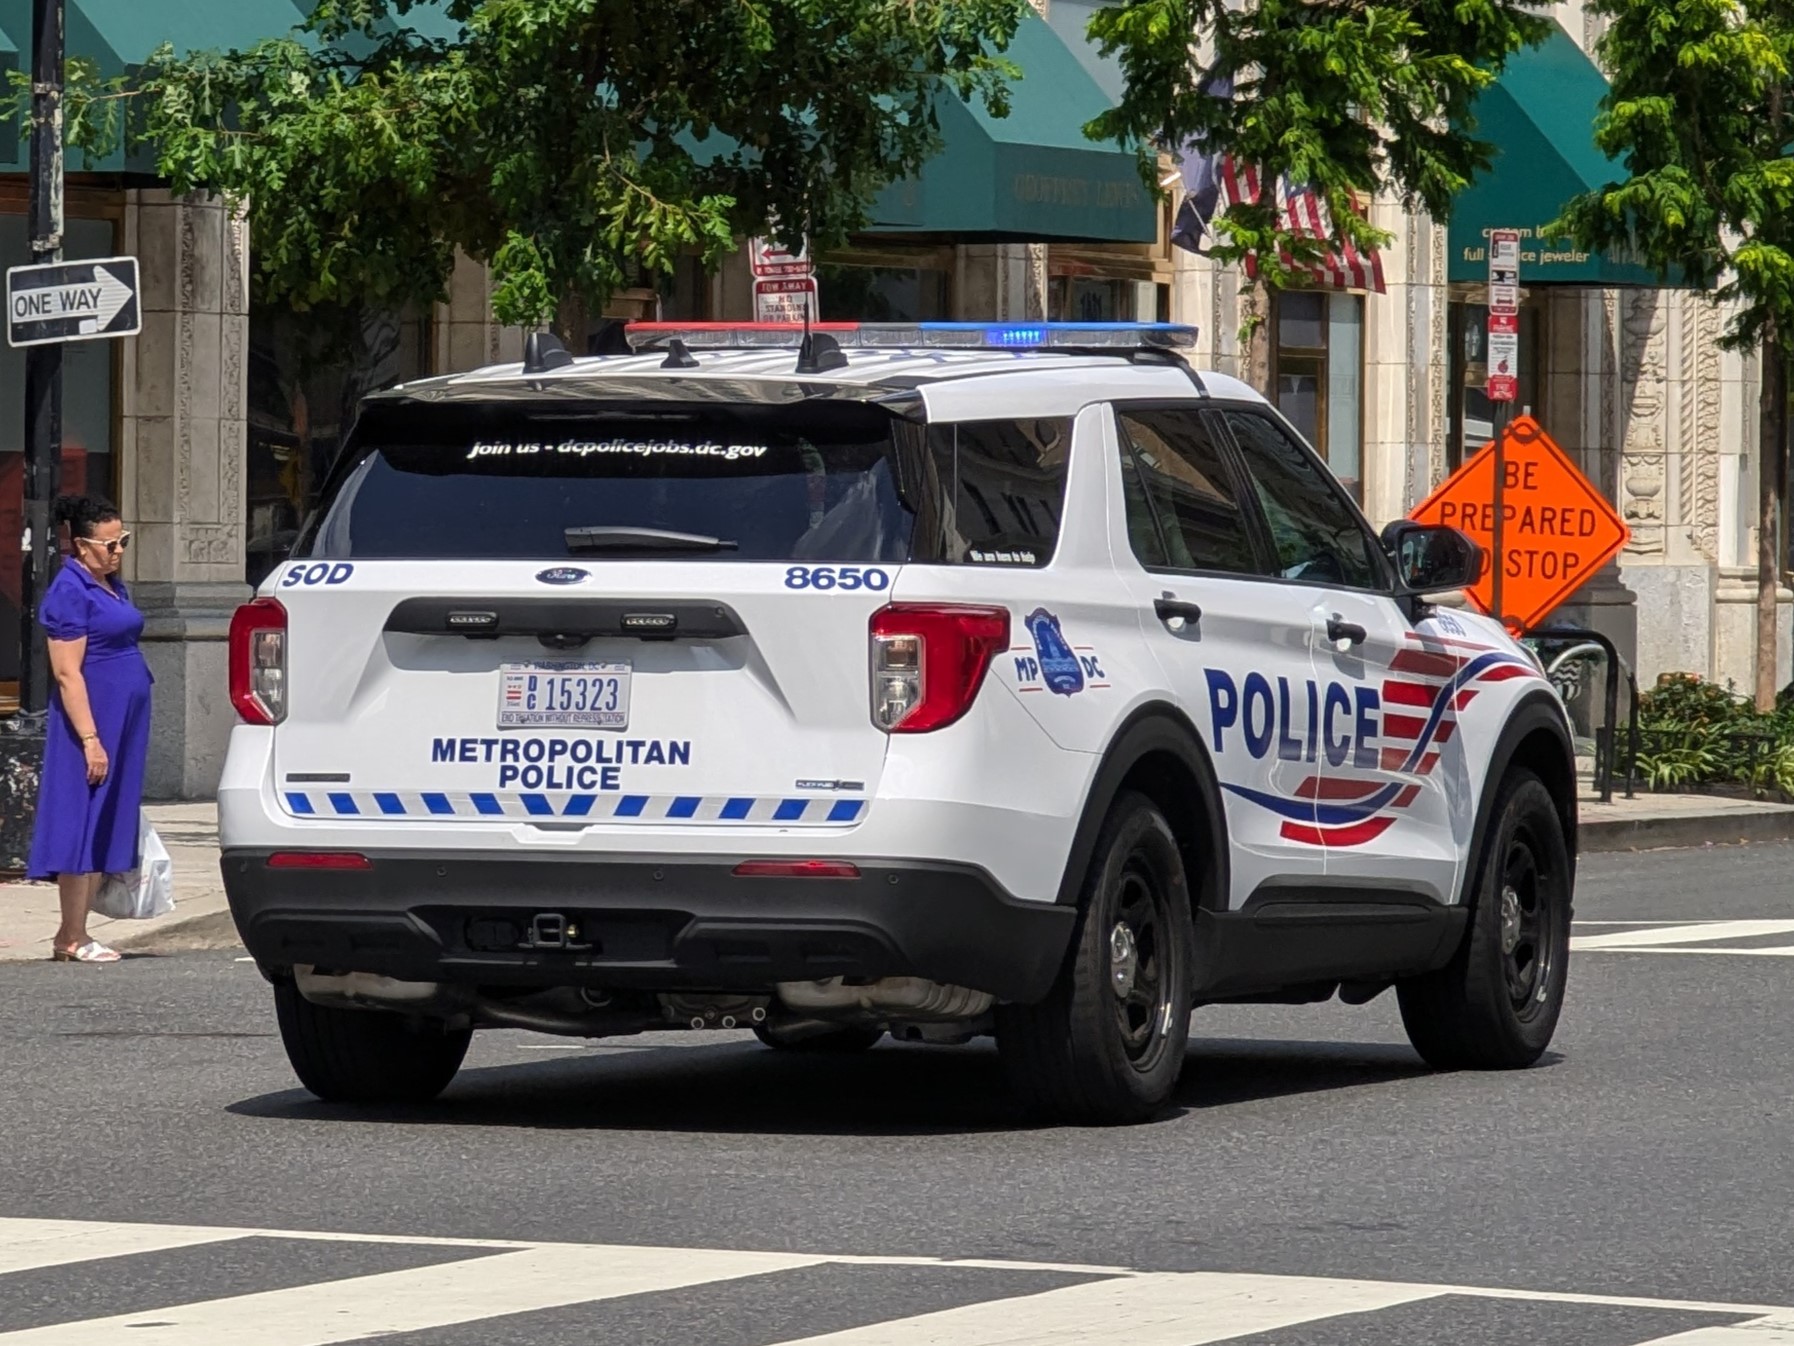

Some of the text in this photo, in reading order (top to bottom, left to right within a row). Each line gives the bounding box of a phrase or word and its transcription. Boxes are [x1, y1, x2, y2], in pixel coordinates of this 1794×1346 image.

[1464, 247, 1484, 261] full
[1540, 248, 1590, 265] jeweler
[762, 281, 807, 292] TOW AWAY
[779, 295, 792, 303] NO
[15, 288, 102, 317] ONE WAY
[466, 441, 512, 459] join
[516, 443, 540, 454] us
[556, 438, 767, 459] dcpolicejobs.dc.gov
[1504, 461, 1538, 490] BE
[1440, 501, 1596, 537] PREPARED
[282, 562, 354, 587] SOD
[1505, 549, 1580, 581] STOP
[784, 566, 889, 591] 8650
[1014, 656, 1038, 682] MP
[1081, 656, 1105, 681] DC
[546, 677, 619, 711] 15323
[1203, 667, 1381, 769] POLICE
[431, 738, 691, 765] METROPOLITAN
[499, 764, 621, 790] POLICE
